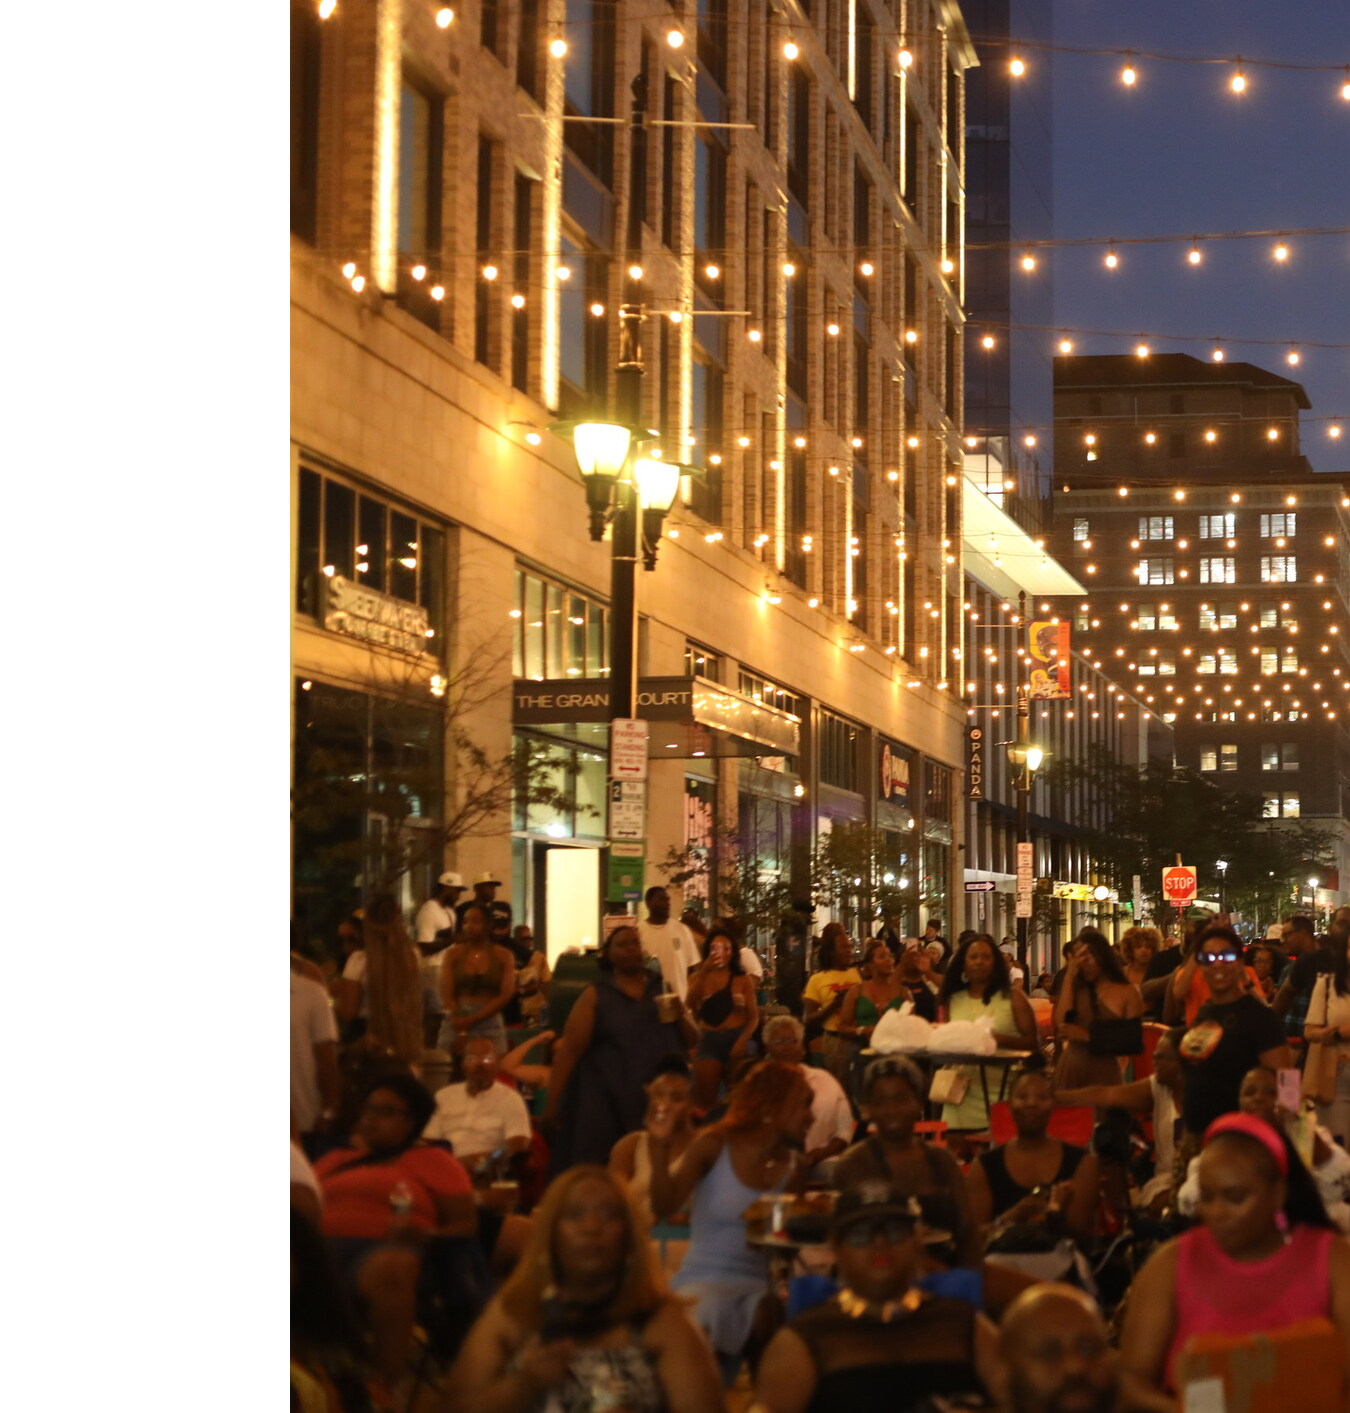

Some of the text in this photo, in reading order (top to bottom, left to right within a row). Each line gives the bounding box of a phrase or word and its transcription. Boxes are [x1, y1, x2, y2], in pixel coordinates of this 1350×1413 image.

[515, 691, 691, 709] THE GRAN OURT
[969, 742, 982, 796] PANDA
[613, 785, 620, 798] 2
[1165, 876, 1195, 890] STOP
